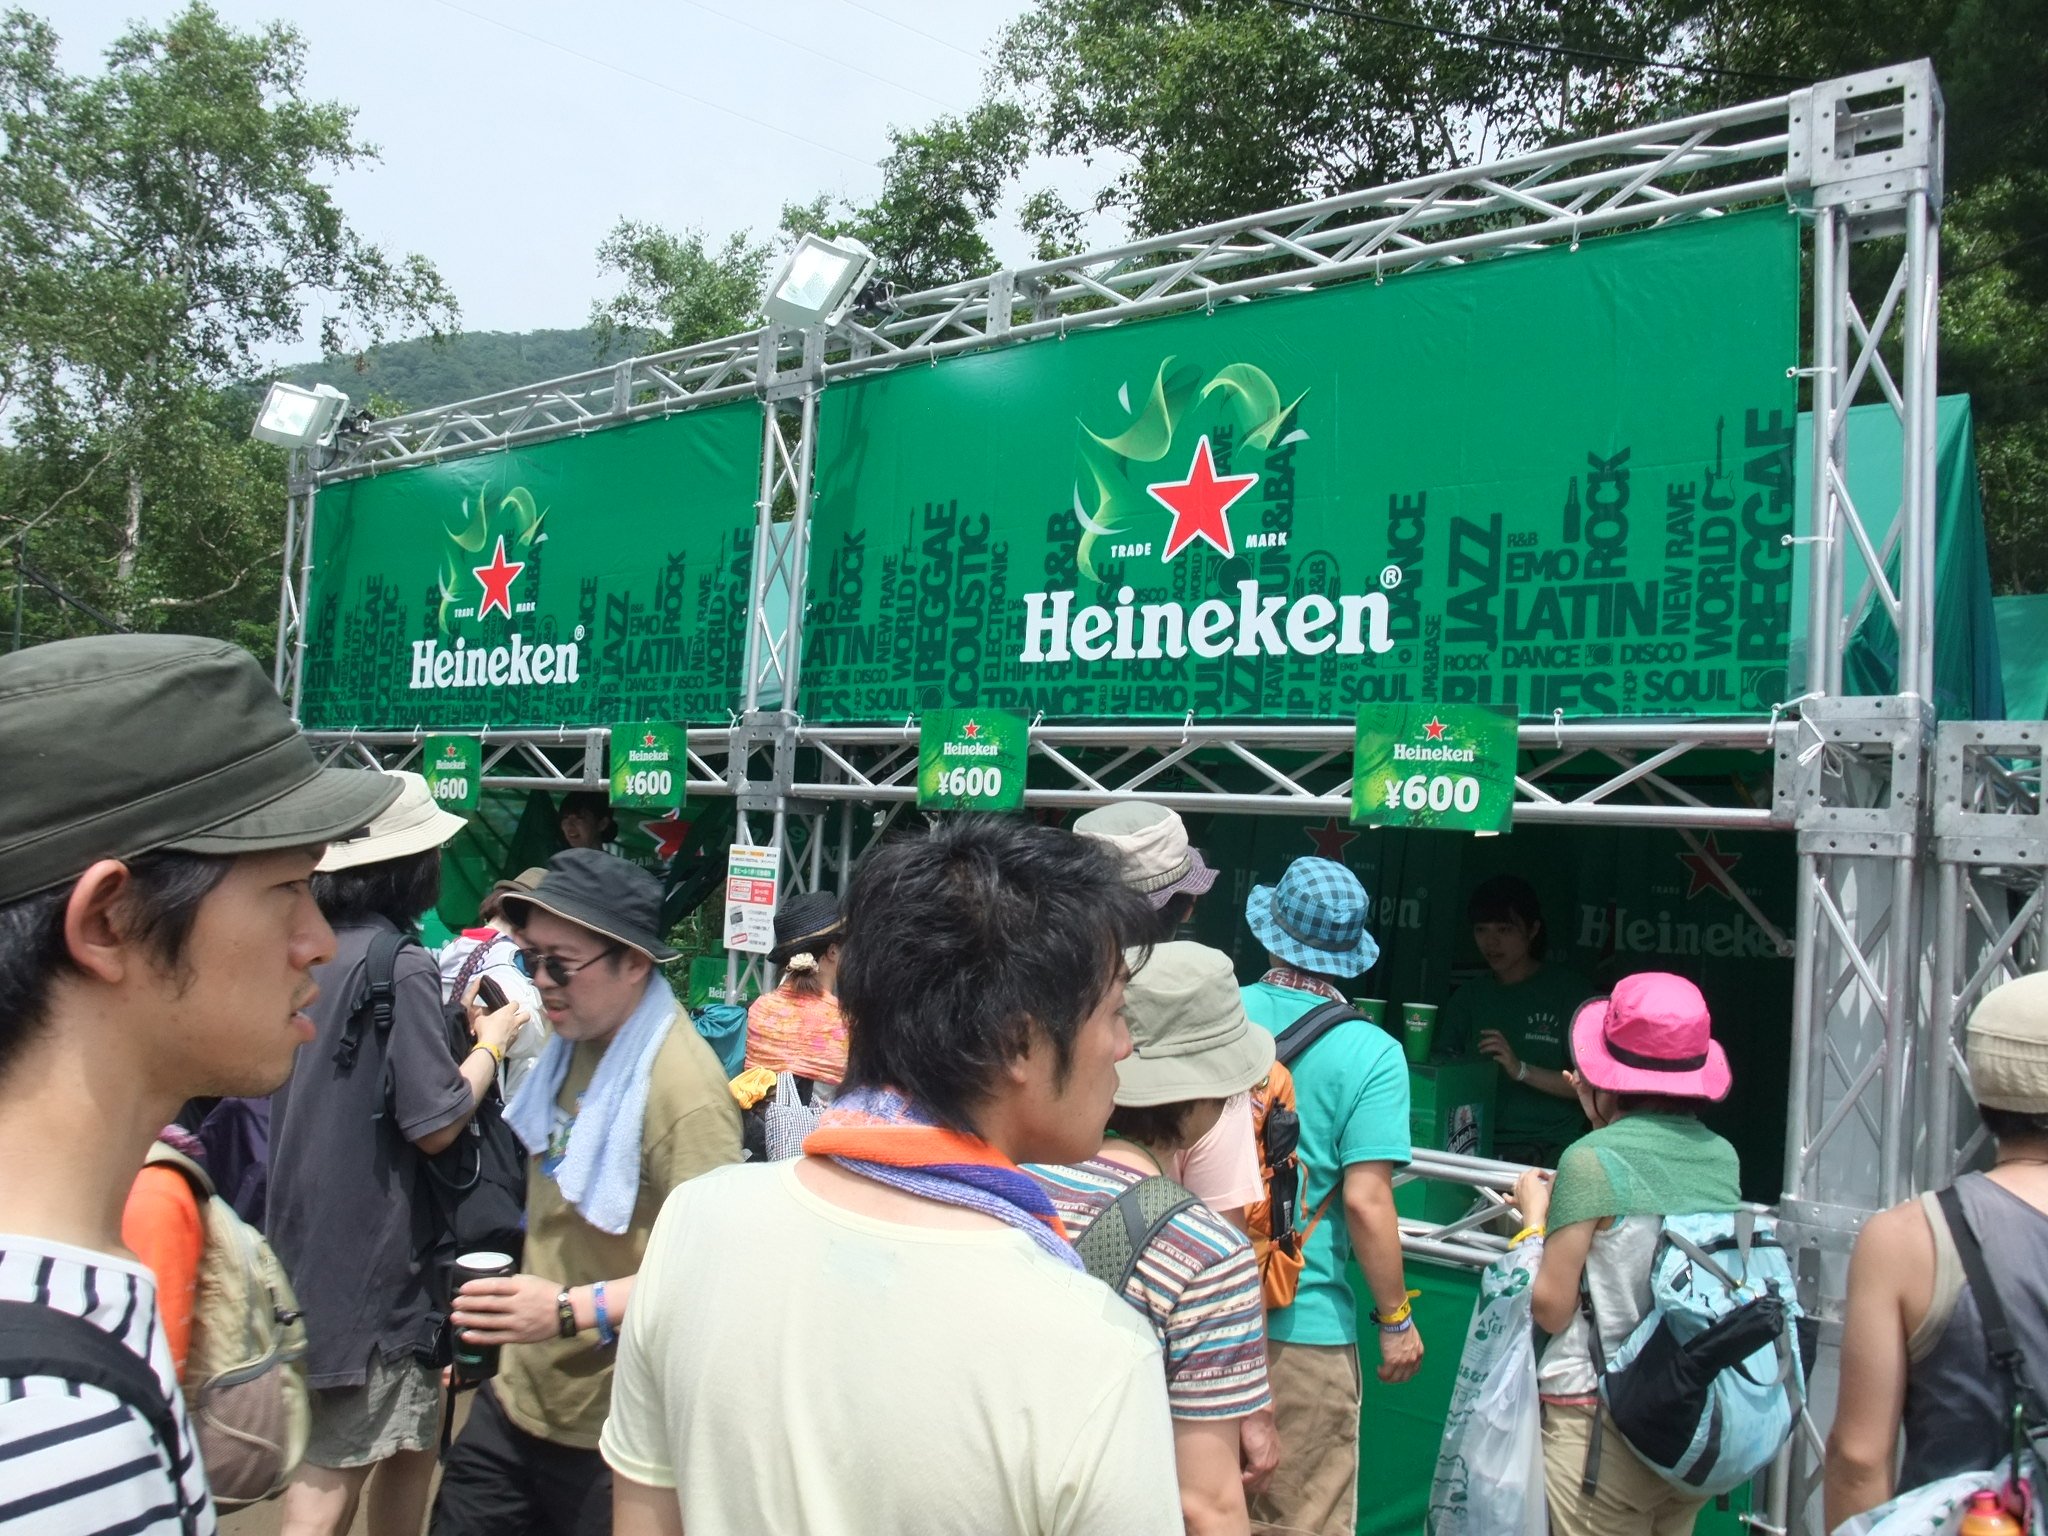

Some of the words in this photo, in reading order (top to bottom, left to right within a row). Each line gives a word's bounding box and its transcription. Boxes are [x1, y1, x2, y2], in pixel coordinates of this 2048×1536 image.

[1583, 447, 1630, 580] ROCK
[1665, 481, 1695, 559] RAVE
[1110, 542, 1152, 559] TRADE
[1245, 532, 1288, 549] MARK
[1507, 533, 1538, 548] R&B
[1737, 408, 1793, 661] REGGAE
[838, 528, 867, 624] ROCK
[880, 553, 899, 610] RAVE
[1386, 491, 1427, 641] DANCE
[1445, 512, 1503, 653] JAZZ
[1505, 550, 1580, 584] EMO
[661, 549, 687, 635] ROCK
[914, 499, 957, 682] REGGAE
[1661, 565, 1693, 635] NEW
[1694, 516, 1736, 661] WORLD
[454, 607, 475, 619] TRADE
[515, 601, 536, 613] MARK
[629, 615, 661, 637] EMO
[725, 527, 755, 689] REGGAE
[983, 541, 1009, 682] ELECTRONIC
[1503, 580, 1660, 641] LATIN
[359, 573, 384, 701] REGGAE
[602, 591, 630, 681] JAZZ
[706, 592, 728, 689] WORLD
[891, 578, 918, 683] WORLD
[626, 636, 694, 674] LATIN
[1443, 654, 1489, 671] ROCK
[1501, 645, 1582, 669] DANCE
[1619, 642, 1688, 665] DISCO
[853, 668, 885, 685] DISCO
[1338, 673, 1415, 704] SOUL
[1641, 668, 1737, 703] SOUL
[684, 692, 728, 715] SOUL
[865, 687, 912, 711] SOUL
[1134, 685, 1189, 713] EMO
[628, 750, 669, 762] Heineken
[943, 742, 998, 756] Heineken
[1393, 743, 1475, 762] Heineken
[433, 778, 468, 800] ¥600
[625, 771, 672, 796] ¥600
[937, 766, 1002, 797] ¥600
[1384, 774, 1481, 813] ¥600
[1576, 903, 1796, 959] Heineke
